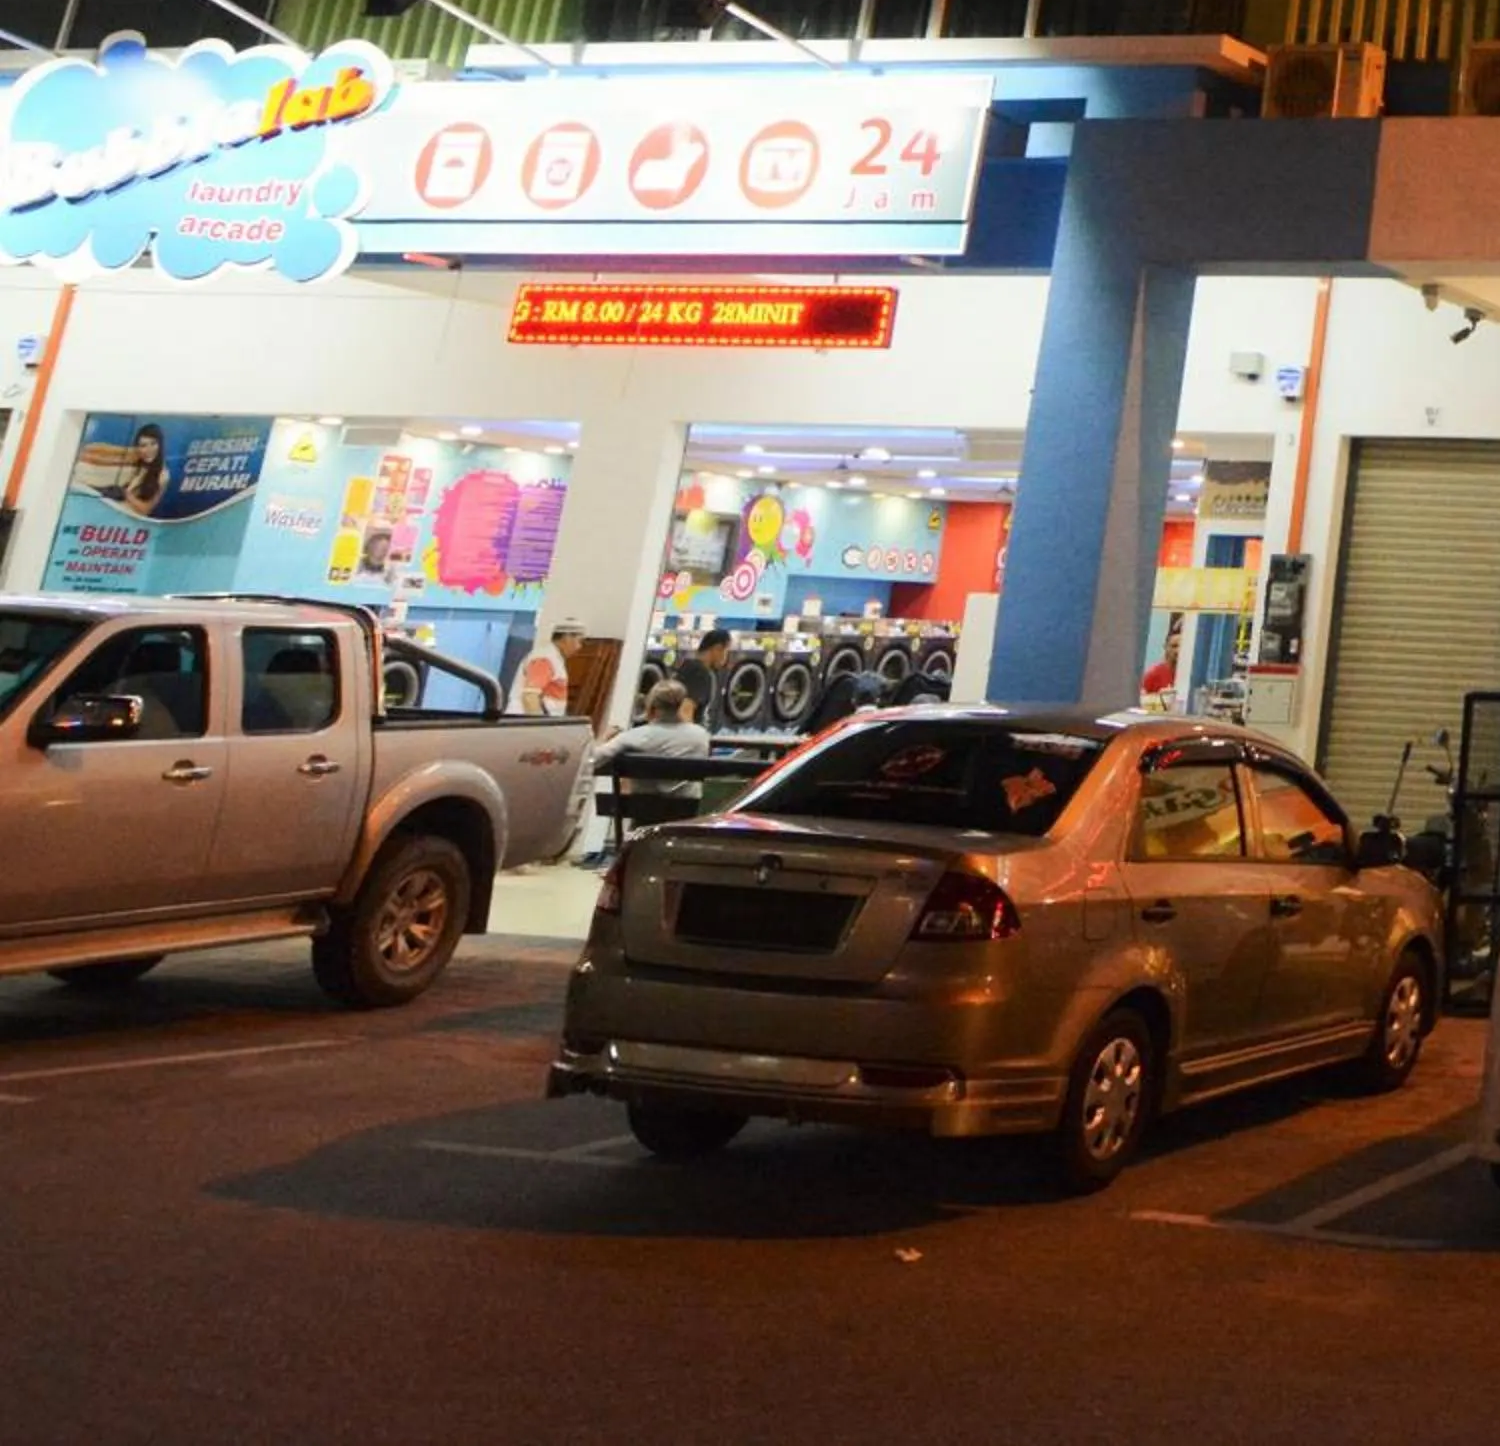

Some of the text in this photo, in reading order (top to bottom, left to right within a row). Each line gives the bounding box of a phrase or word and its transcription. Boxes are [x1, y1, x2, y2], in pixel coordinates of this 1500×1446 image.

[849, 118, 941, 176] 24
[188, 181, 303, 207] laundry
[178, 214, 284, 242] arcade
[542, 300, 582, 323] RM
[639, 301, 664, 324] 24
[667, 301, 703, 324] KG
[79, 524, 149, 545] BUILD
